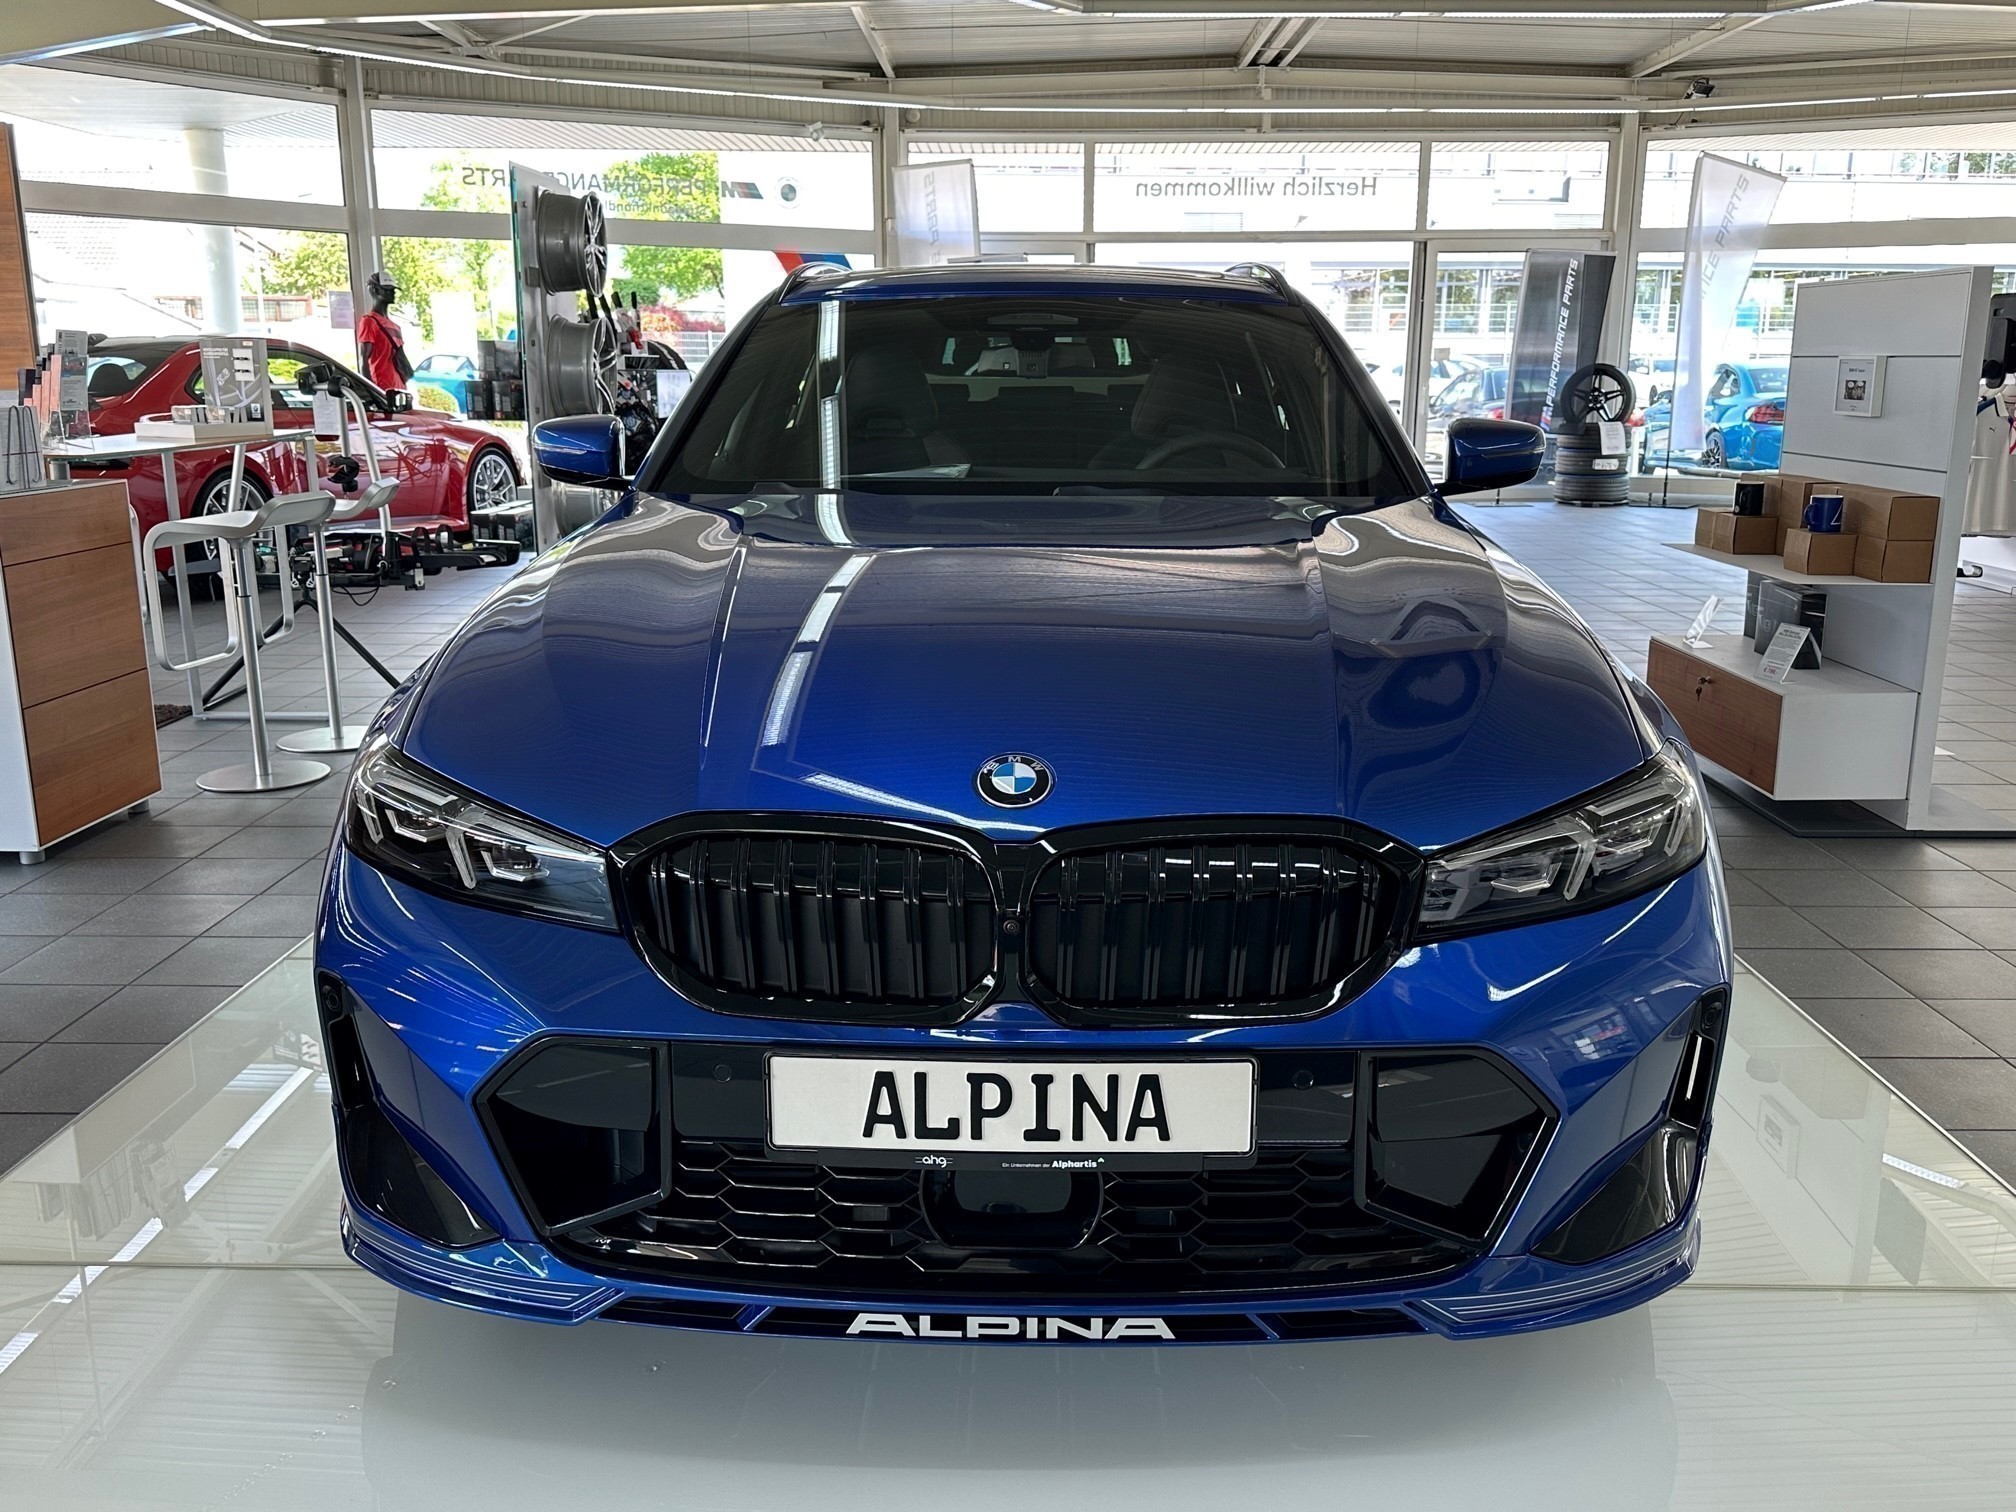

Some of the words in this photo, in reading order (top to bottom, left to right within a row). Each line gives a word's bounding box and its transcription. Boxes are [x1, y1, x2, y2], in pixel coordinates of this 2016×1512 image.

[1715, 173, 1750, 249] PARTS
[1545, 307, 1570, 407] PERFORMANCE
[1562, 258, 1579, 306] PARTS
[862, 1070, 1171, 1142] ALPINA
[922, 1155, 948, 1168] ahg
[1052, 1159, 1098, 1169] Alphartis
[846, 1313, 1176, 1339] ALPINA
